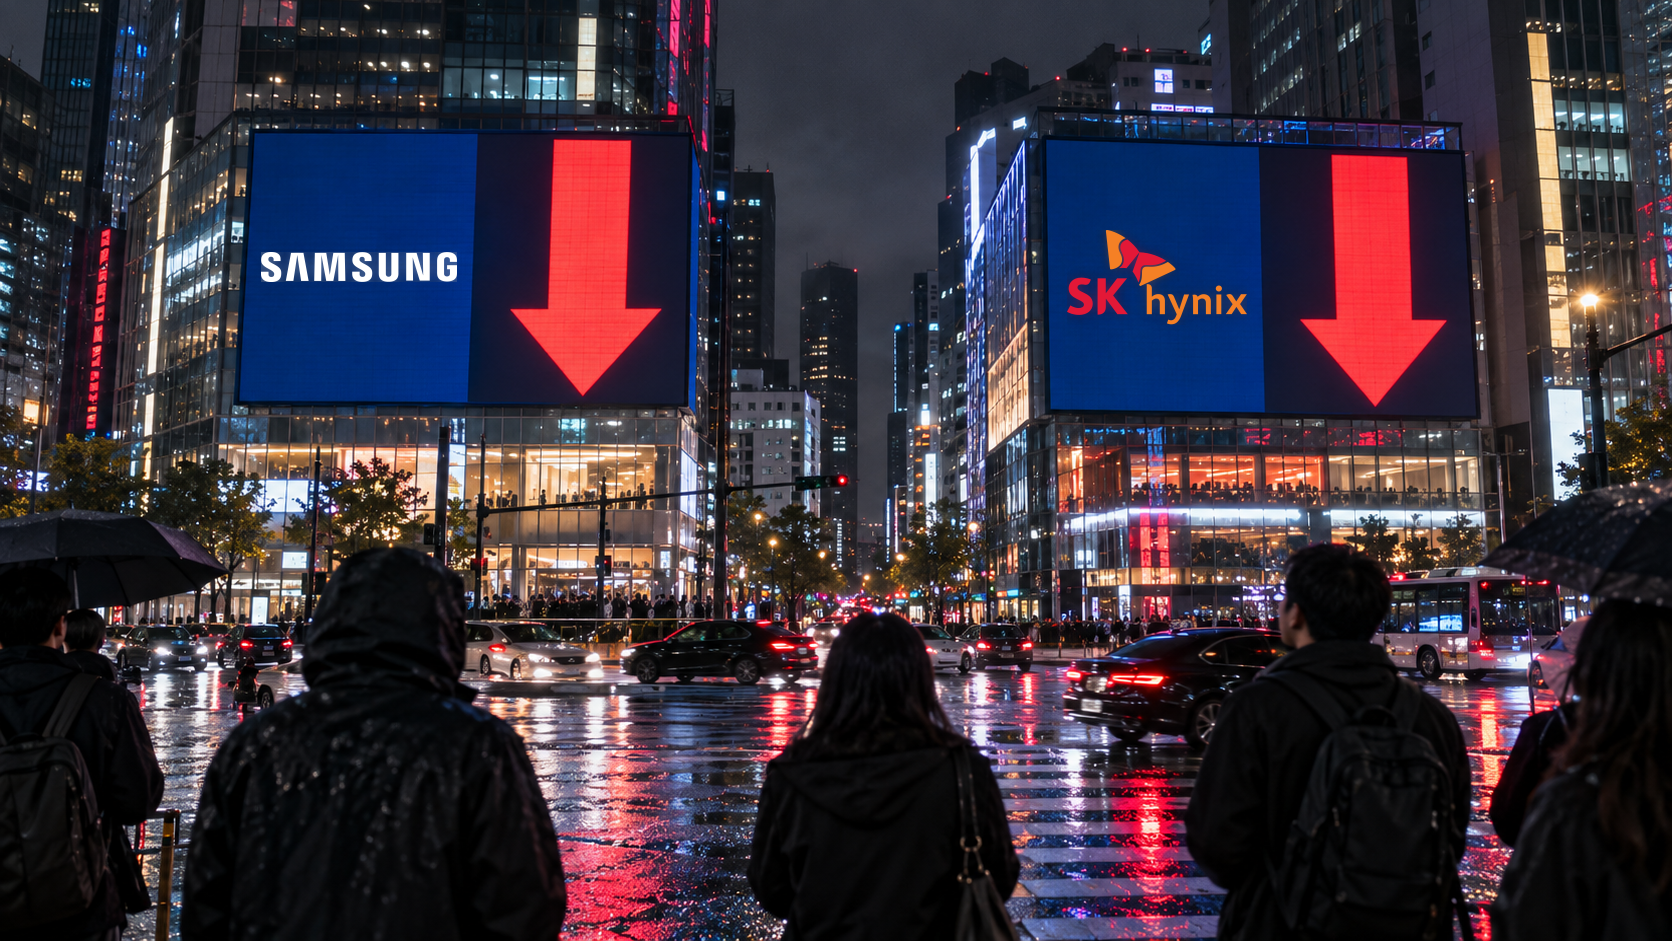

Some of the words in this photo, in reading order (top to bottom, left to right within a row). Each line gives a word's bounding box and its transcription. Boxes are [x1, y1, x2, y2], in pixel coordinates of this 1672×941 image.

[261, 252, 458, 282] SAMSUNG
[1067, 277, 1128, 315] SK
[1146, 284, 1247, 325] hynix
